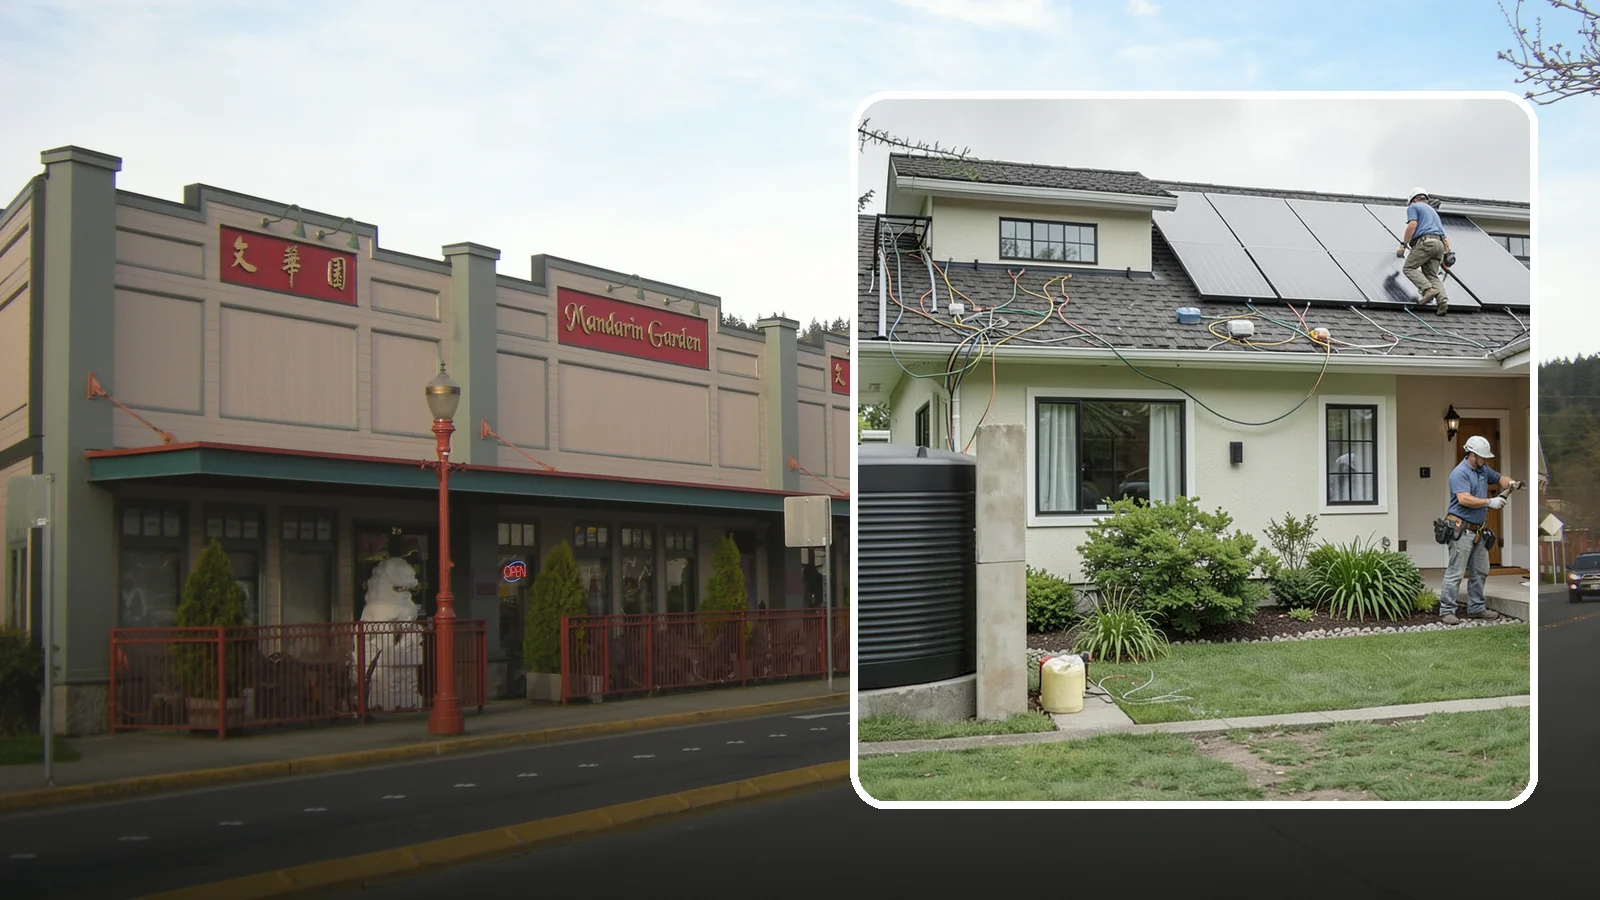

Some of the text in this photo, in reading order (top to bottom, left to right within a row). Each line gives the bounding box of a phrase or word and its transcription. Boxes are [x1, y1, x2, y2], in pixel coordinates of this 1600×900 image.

[231, 236, 347, 291] 文華園
[565, 302, 701, 352] Mandarin Garden
[503, 565, 527, 578] OPEN
